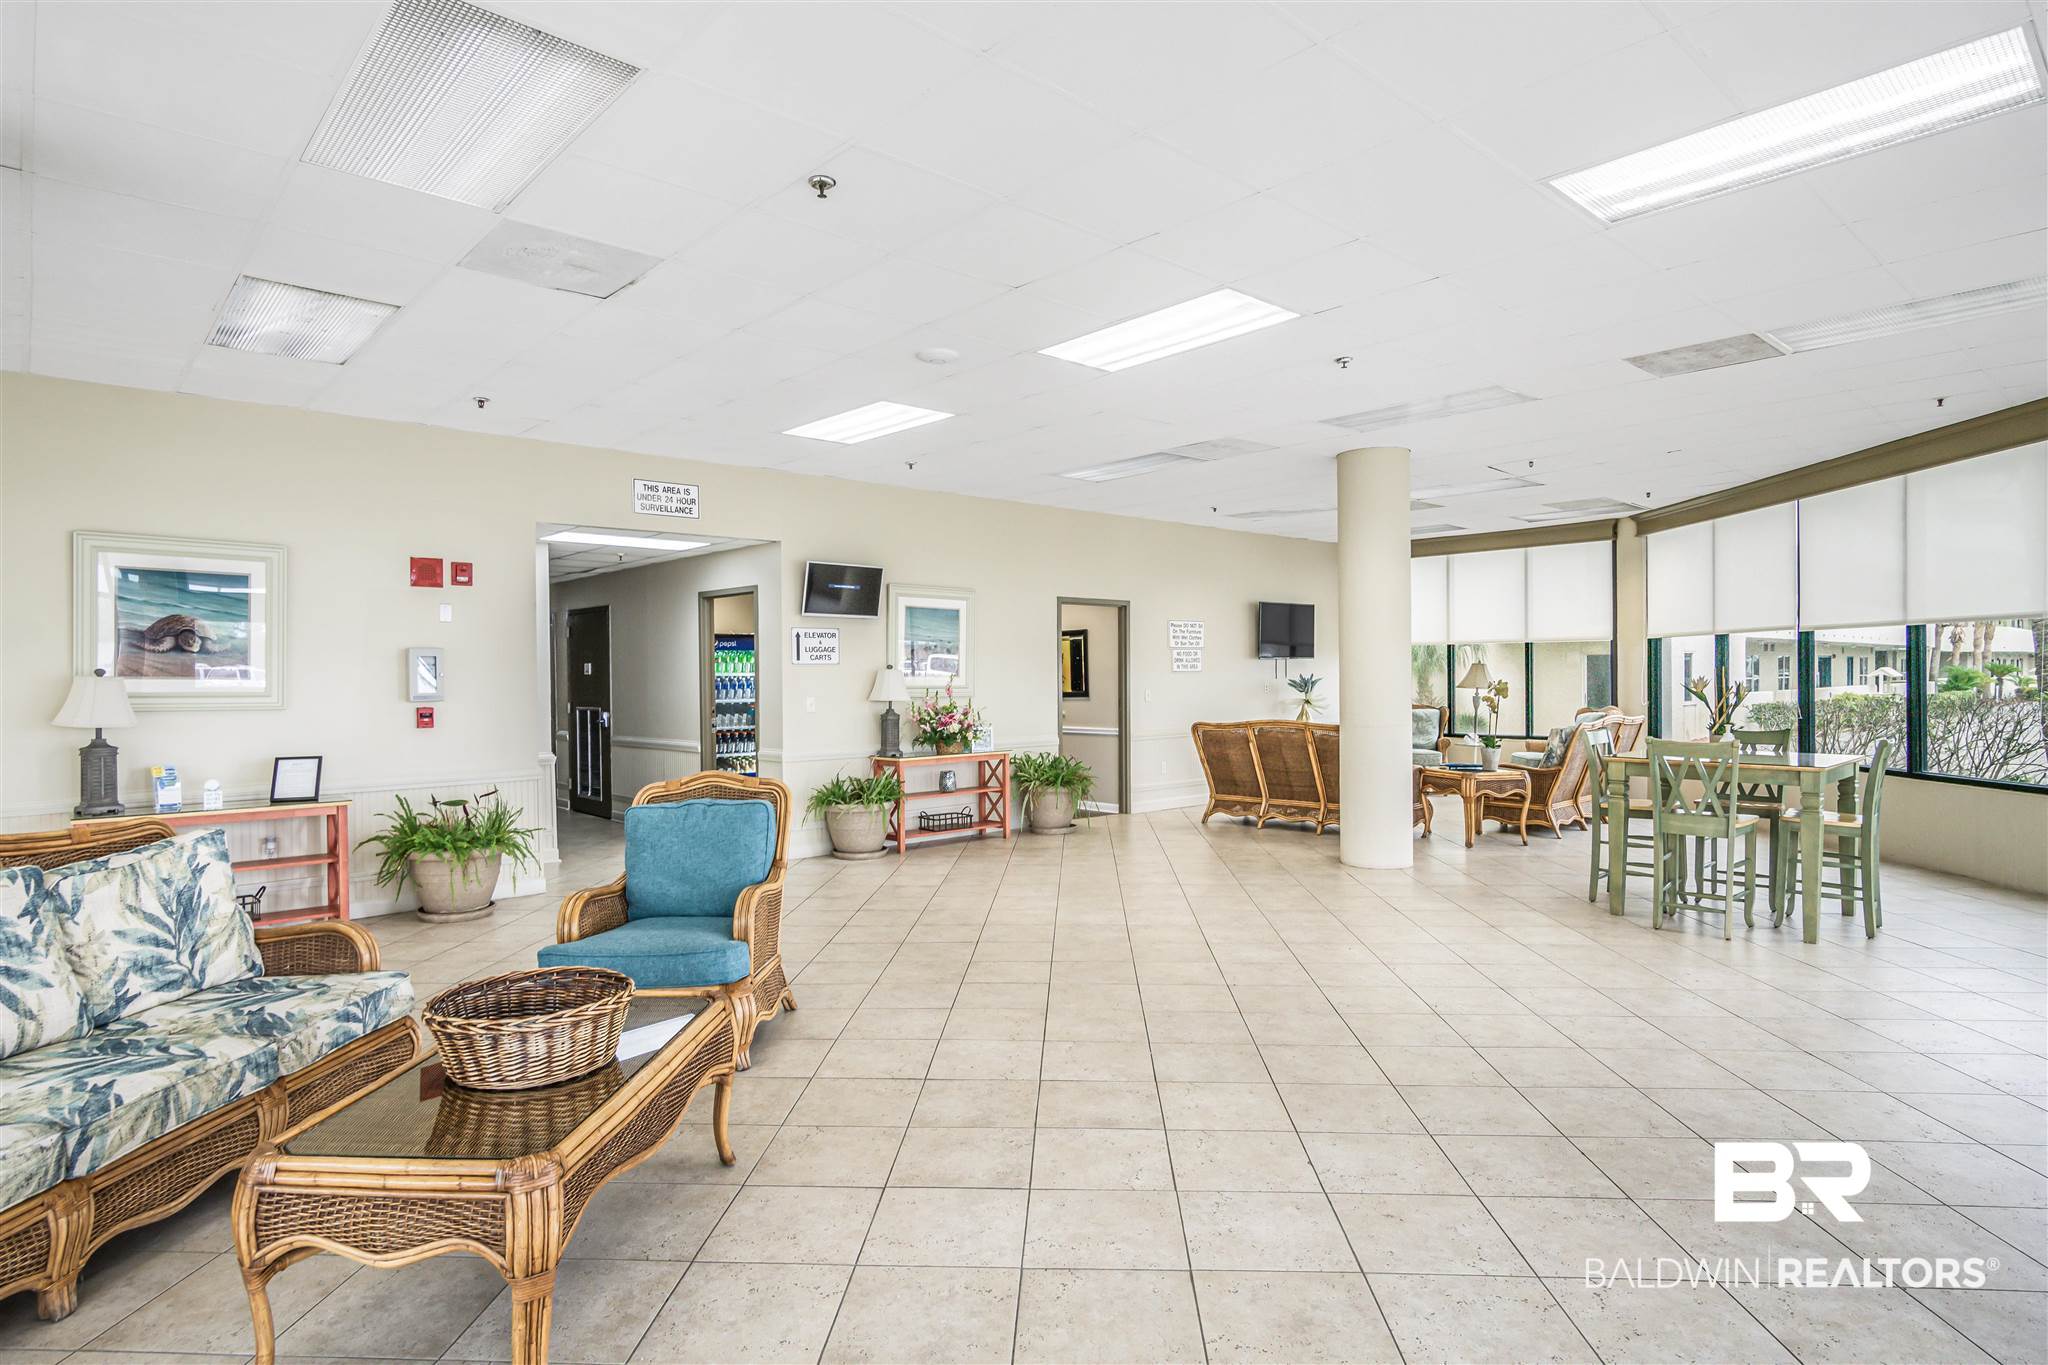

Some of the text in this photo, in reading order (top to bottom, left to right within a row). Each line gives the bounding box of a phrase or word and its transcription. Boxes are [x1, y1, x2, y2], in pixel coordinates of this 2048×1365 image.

[643, 484, 691, 496] THIS AREA IS
[637, 493, 696, 506] UNDER 24 HOUR
[640, 503, 694, 515] SURVEILLANCE
[804, 631, 837, 639] ELEVATOR
[719, 640, 737, 648] pepsi
